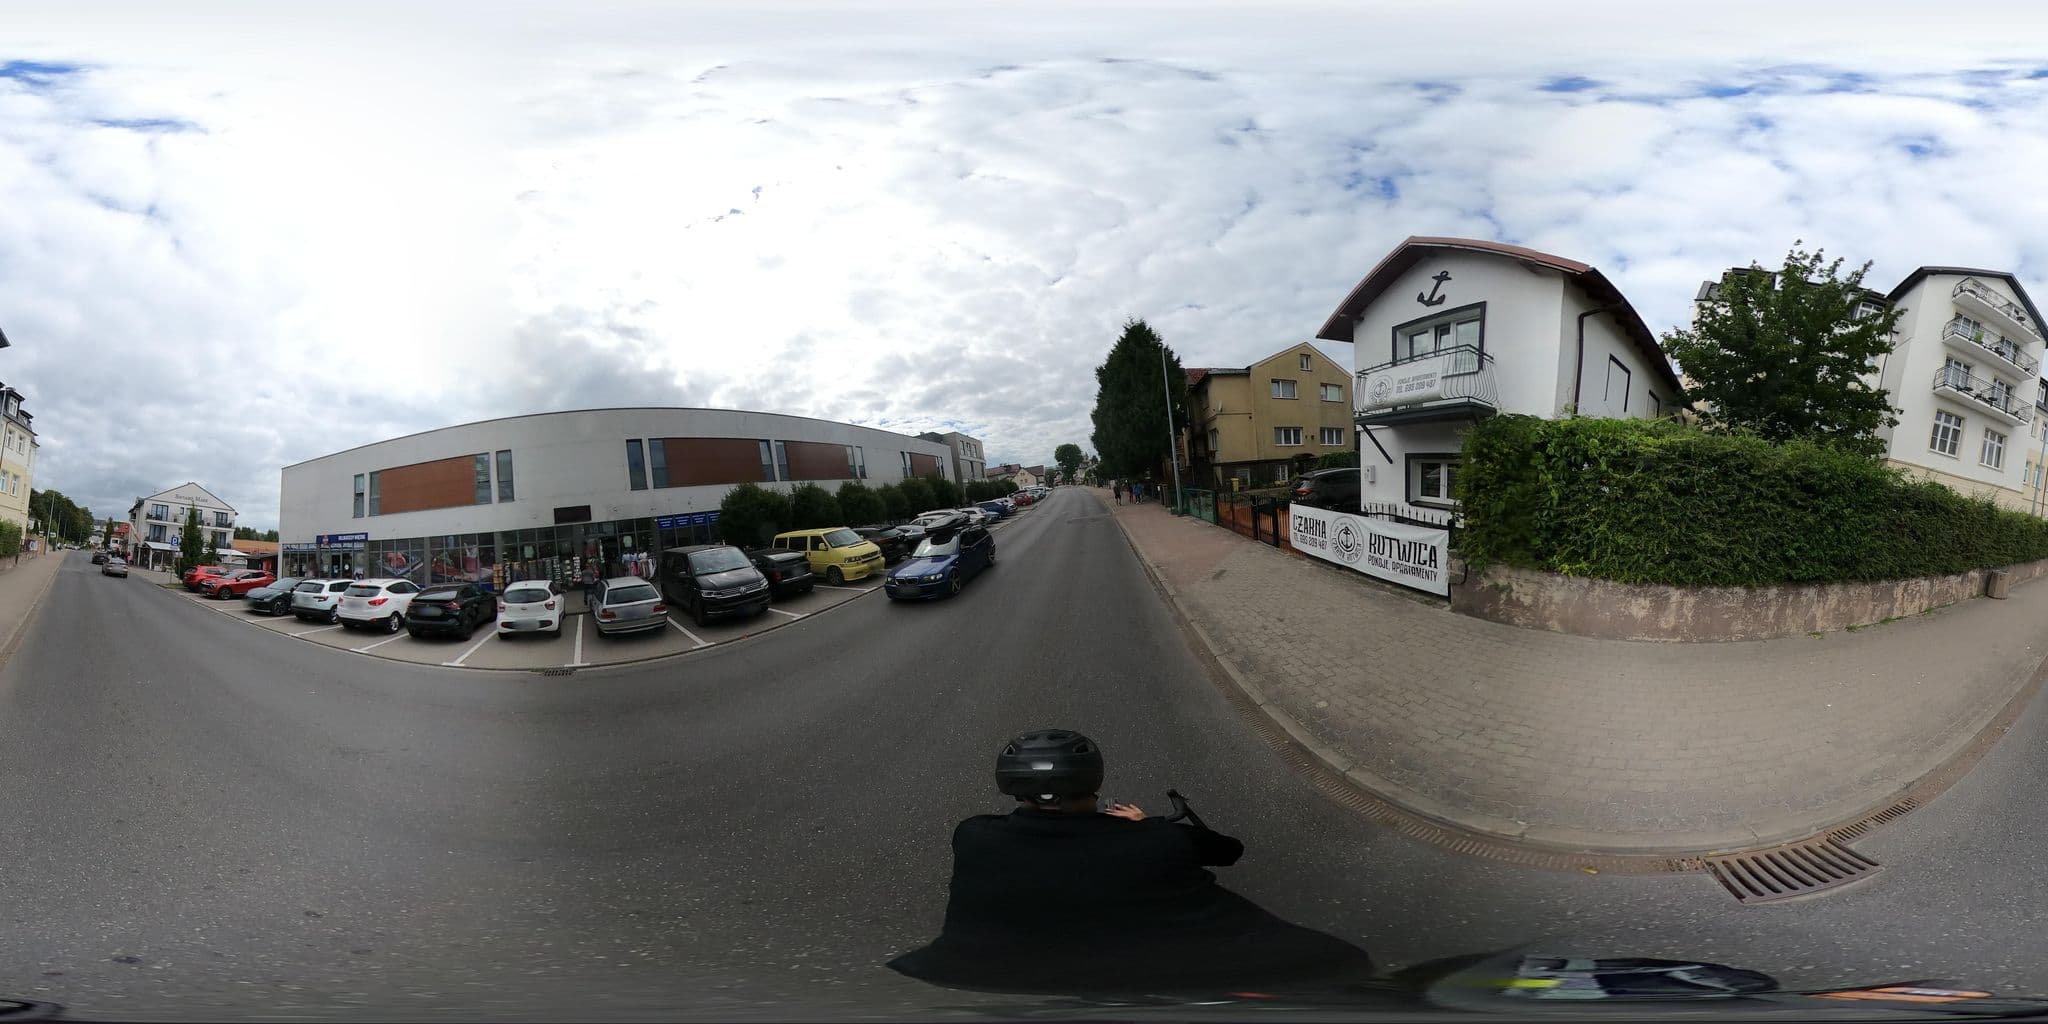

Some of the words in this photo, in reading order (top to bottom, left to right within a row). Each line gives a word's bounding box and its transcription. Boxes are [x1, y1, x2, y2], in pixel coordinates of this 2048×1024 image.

[1293, 514, 1327, 539] CZARNA
[1308, 536, 1318, 548] 209
[1318, 539, 1327, 550] 487
[1369, 533, 1438, 569] KOTWICA
[1368, 555, 1391, 571] POKOJE,
[1391, 561, 1438, 582] APARTAMENTY
